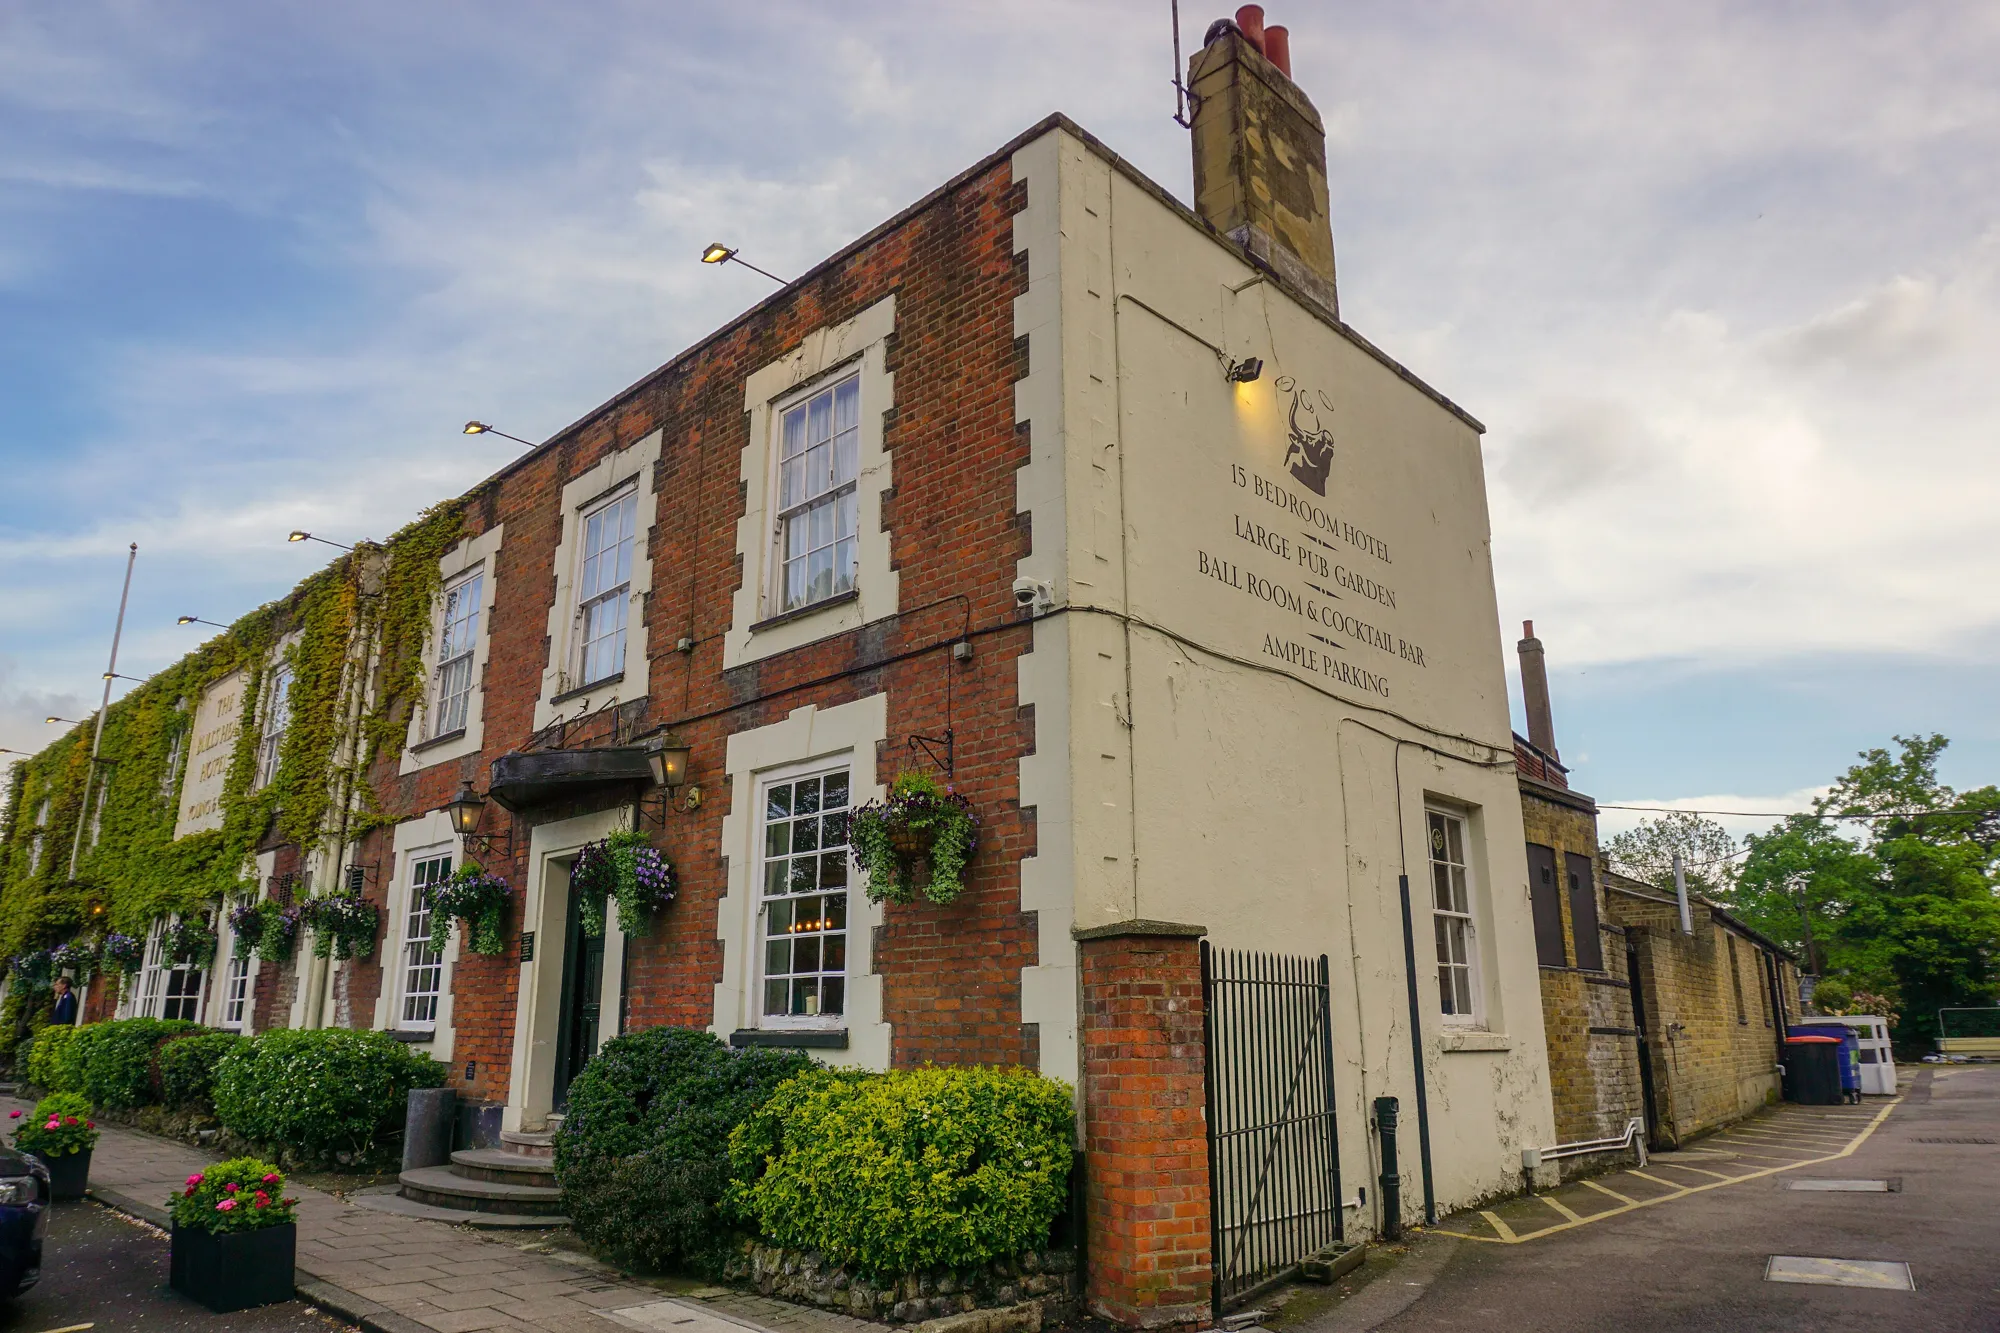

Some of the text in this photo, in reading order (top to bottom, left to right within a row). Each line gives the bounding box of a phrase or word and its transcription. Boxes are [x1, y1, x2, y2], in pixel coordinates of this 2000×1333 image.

[1231, 463, 1392, 565] 15 BEDROOM HOTEL
[1234, 513, 1397, 610] LARGE PUB GARDEN
[1198, 549, 1427, 669] BALL ROOM & COCKTAIL BAR
[1262, 632, 1389, 698] AMPLE PARKING
